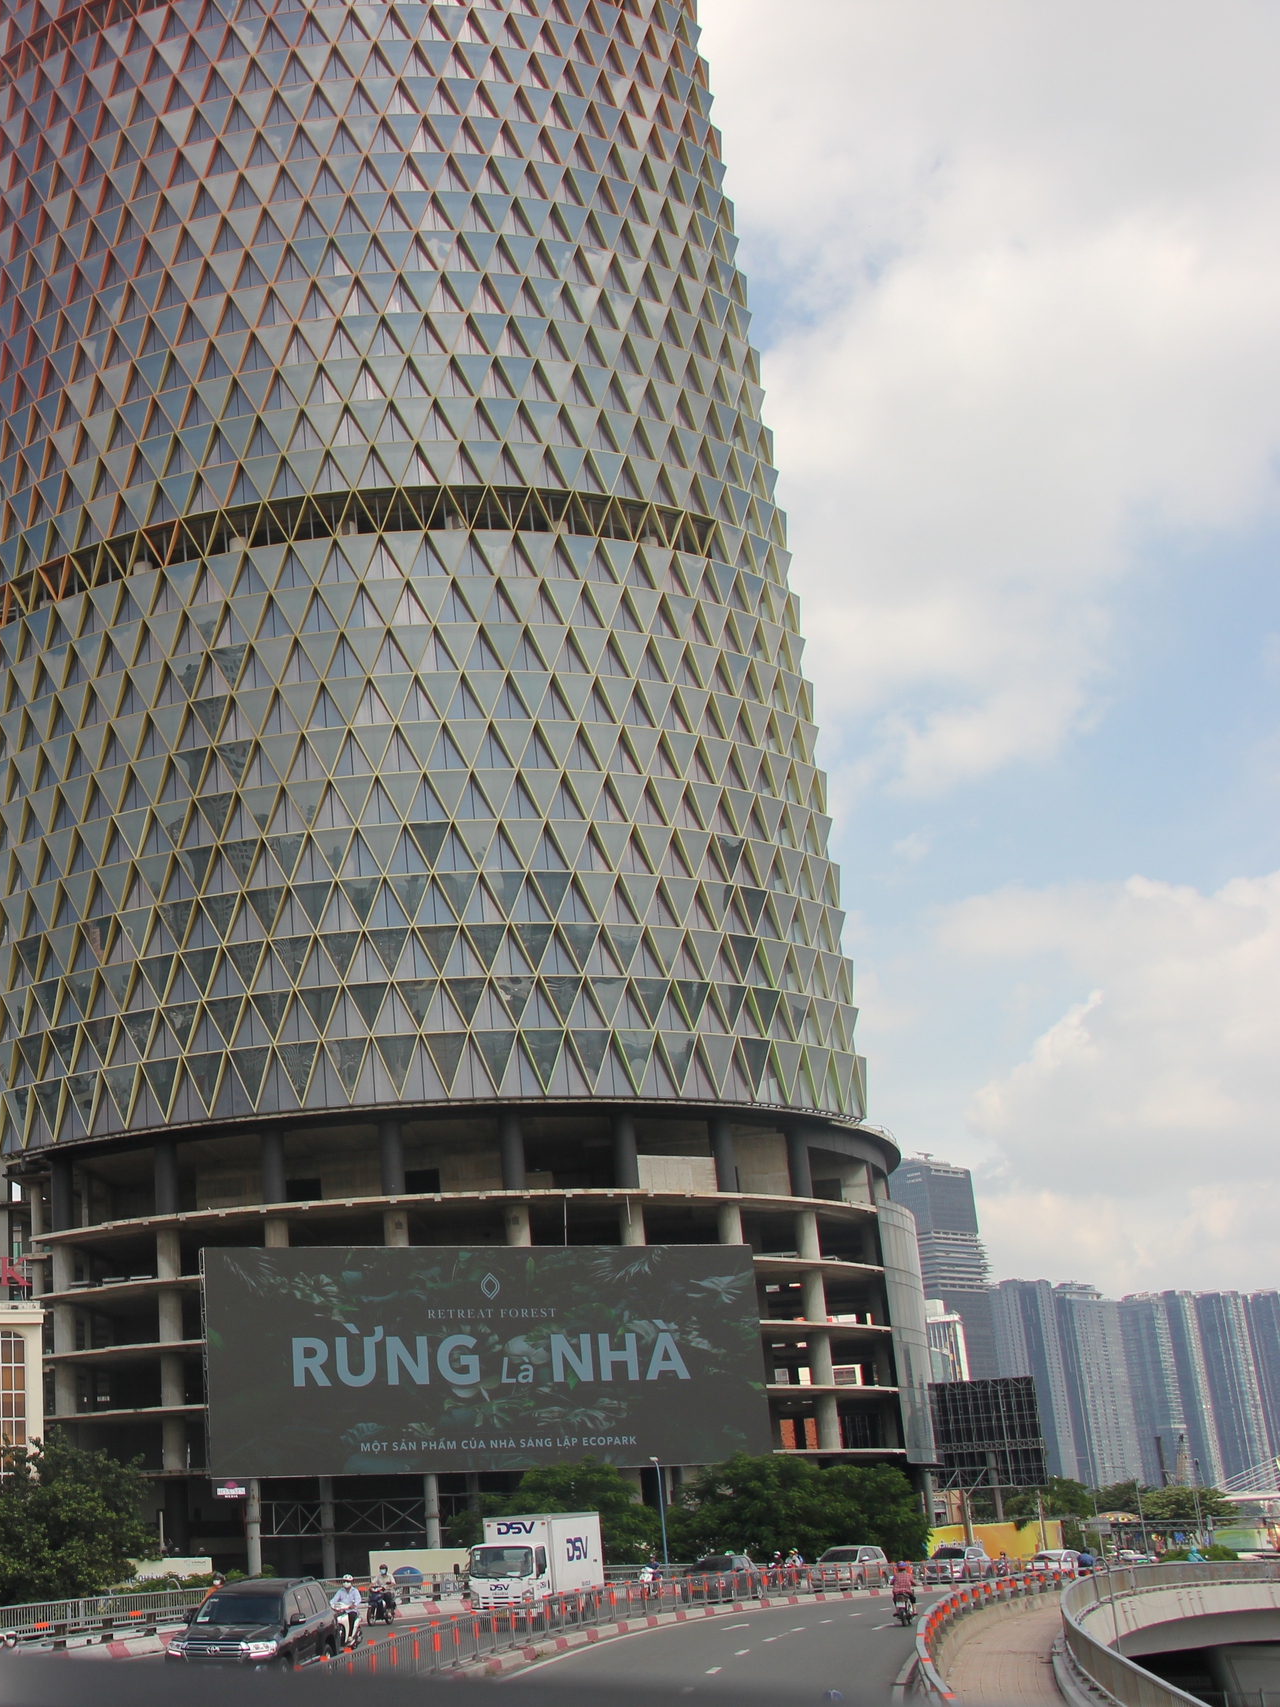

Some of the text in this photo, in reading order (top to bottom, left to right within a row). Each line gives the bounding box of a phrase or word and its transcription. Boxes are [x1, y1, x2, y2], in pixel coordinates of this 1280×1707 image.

[427, 1308, 556, 1319] RETREAT FOREST
[291, 1319, 692, 1388] RỪNG Là NHÀ
[360, 1436, 637, 1454] MỘT SẢN PHẨM CỦA NHÀ SÁNG LẬP ECOPARK
[497, 1521, 535, 1535] DSV
[566, 1536, 588, 1562] DSV
[489, 1583, 510, 1591] DSV
